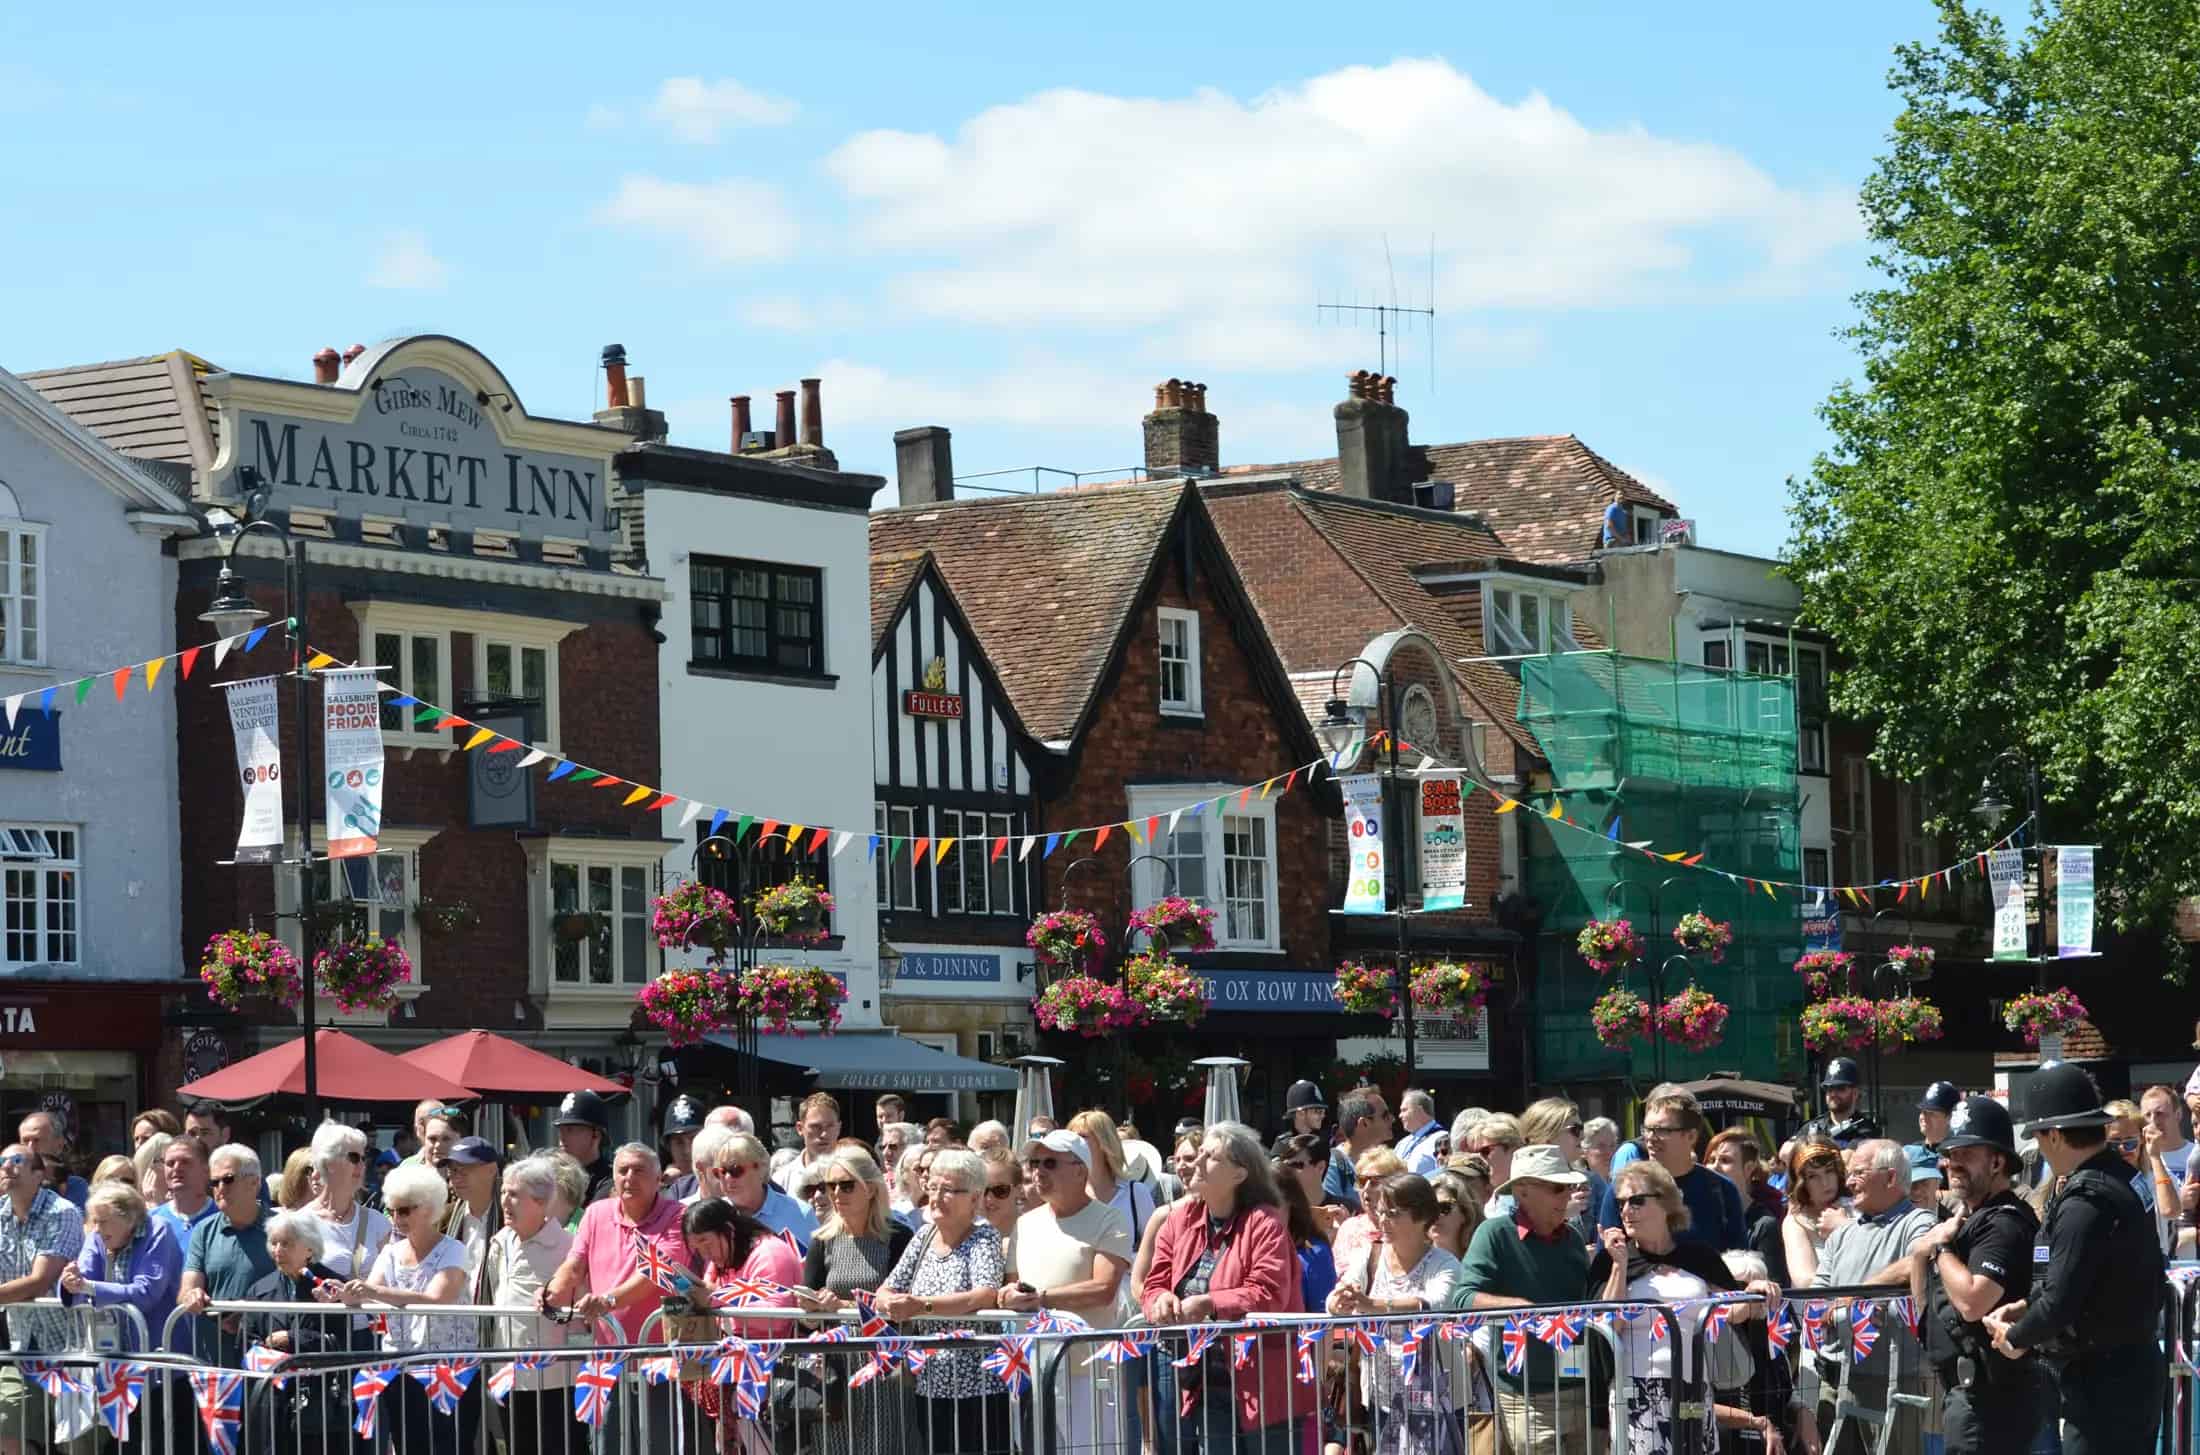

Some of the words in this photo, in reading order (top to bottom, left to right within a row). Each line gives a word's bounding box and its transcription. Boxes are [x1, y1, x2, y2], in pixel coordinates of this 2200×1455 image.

[376, 386, 431, 415] GIBBS
[436, 385, 480, 430] MEW
[434, 426, 457, 442] 1742
[250, 419, 487, 510] MARKET
[503, 453, 596, 523] INN
[327, 694, 376, 704] SALISBURY
[233, 703, 276, 719] VINTAGE
[327, 703, 377, 717] FOODIE
[236, 715, 274, 730] MARKET
[327, 714, 377, 730] FRIDAY
[1423, 780, 1457, 796] CAR
[1992, 871, 2022, 880] MARKET
[915, 957, 927, 976] &
[933, 957, 990, 977] DINING
[1226, 980, 1249, 1001] OX
[1257, 980, 1297, 1001] ROW
[1304, 982, 1335, 1002] INN
[0, 1008, 36, 1033] TA
[840, 1072, 888, 1087] FULLER
[893, 1072, 932, 1088] SMITH
[951, 1073, 998, 1089] TURNER
